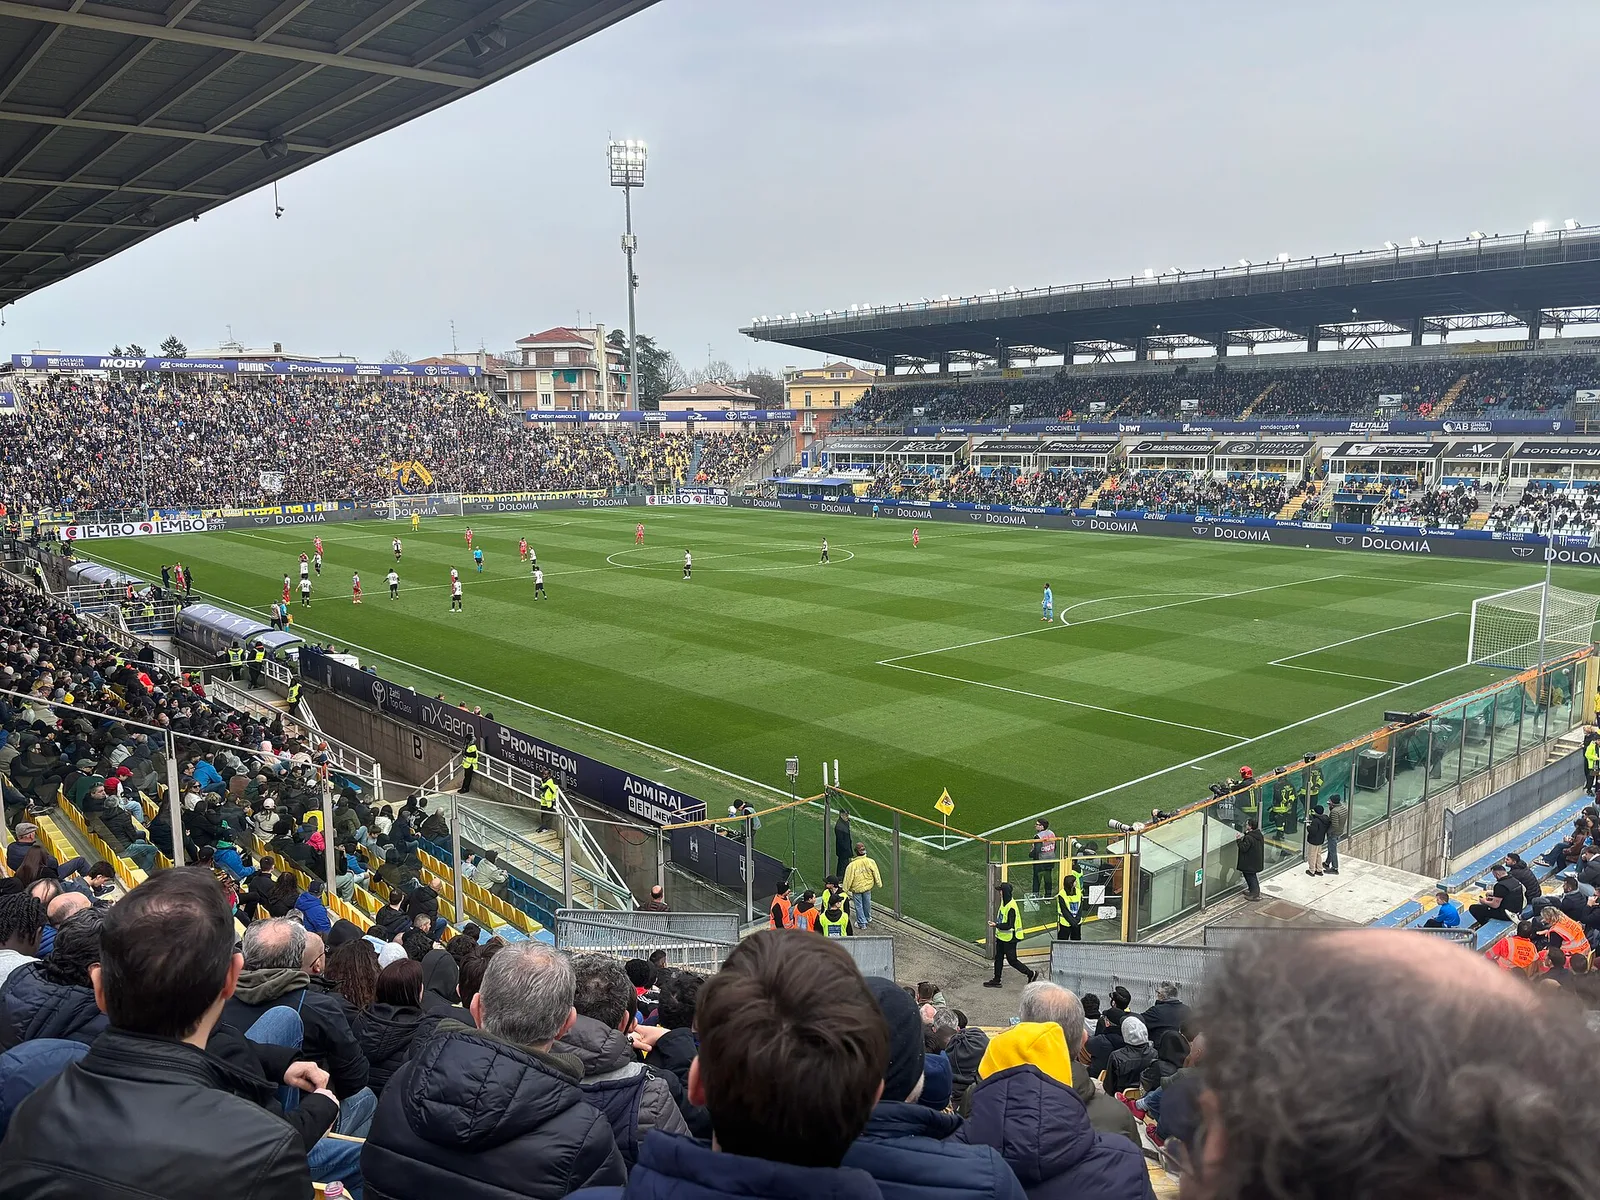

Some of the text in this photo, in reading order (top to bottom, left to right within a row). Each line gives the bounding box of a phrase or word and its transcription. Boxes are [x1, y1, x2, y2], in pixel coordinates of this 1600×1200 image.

[1499, 341, 1526, 351] BALKAN
[100, 358, 147, 369] MOBY
[238, 362, 266, 372] PUMA
[287, 364, 344, 374] PROMETEON
[588, 412, 621, 420] MOBY
[1350, 421, 1389, 429] PULITALIA
[1455, 422, 1469, 430] AB
[498, 502, 539, 511] DOLOMIA
[592, 497, 629, 507] DOLOMIA
[753, 499, 782, 509] DOLOMIA
[394, 506, 438, 517] DOLOMIA
[821, 503, 852, 513] DOLOMIA
[897, 508, 933, 519] DOLOMIA
[1009, 505, 1046, 514] PROMETEON
[276, 512, 326, 525] DOLOMIA
[986, 513, 1027, 525] DOLOMIA
[1090, 519, 1139, 533] DOLOMIA
[1214, 526, 1271, 542] DOLOMIA
[1361, 536, 1431, 553] DOLOMIA
[412, 733, 423, 760] B
[497, 726, 578, 776] PROMETEON
[518, 756, 535, 770] MADE
[628, 797, 651, 818] BET
